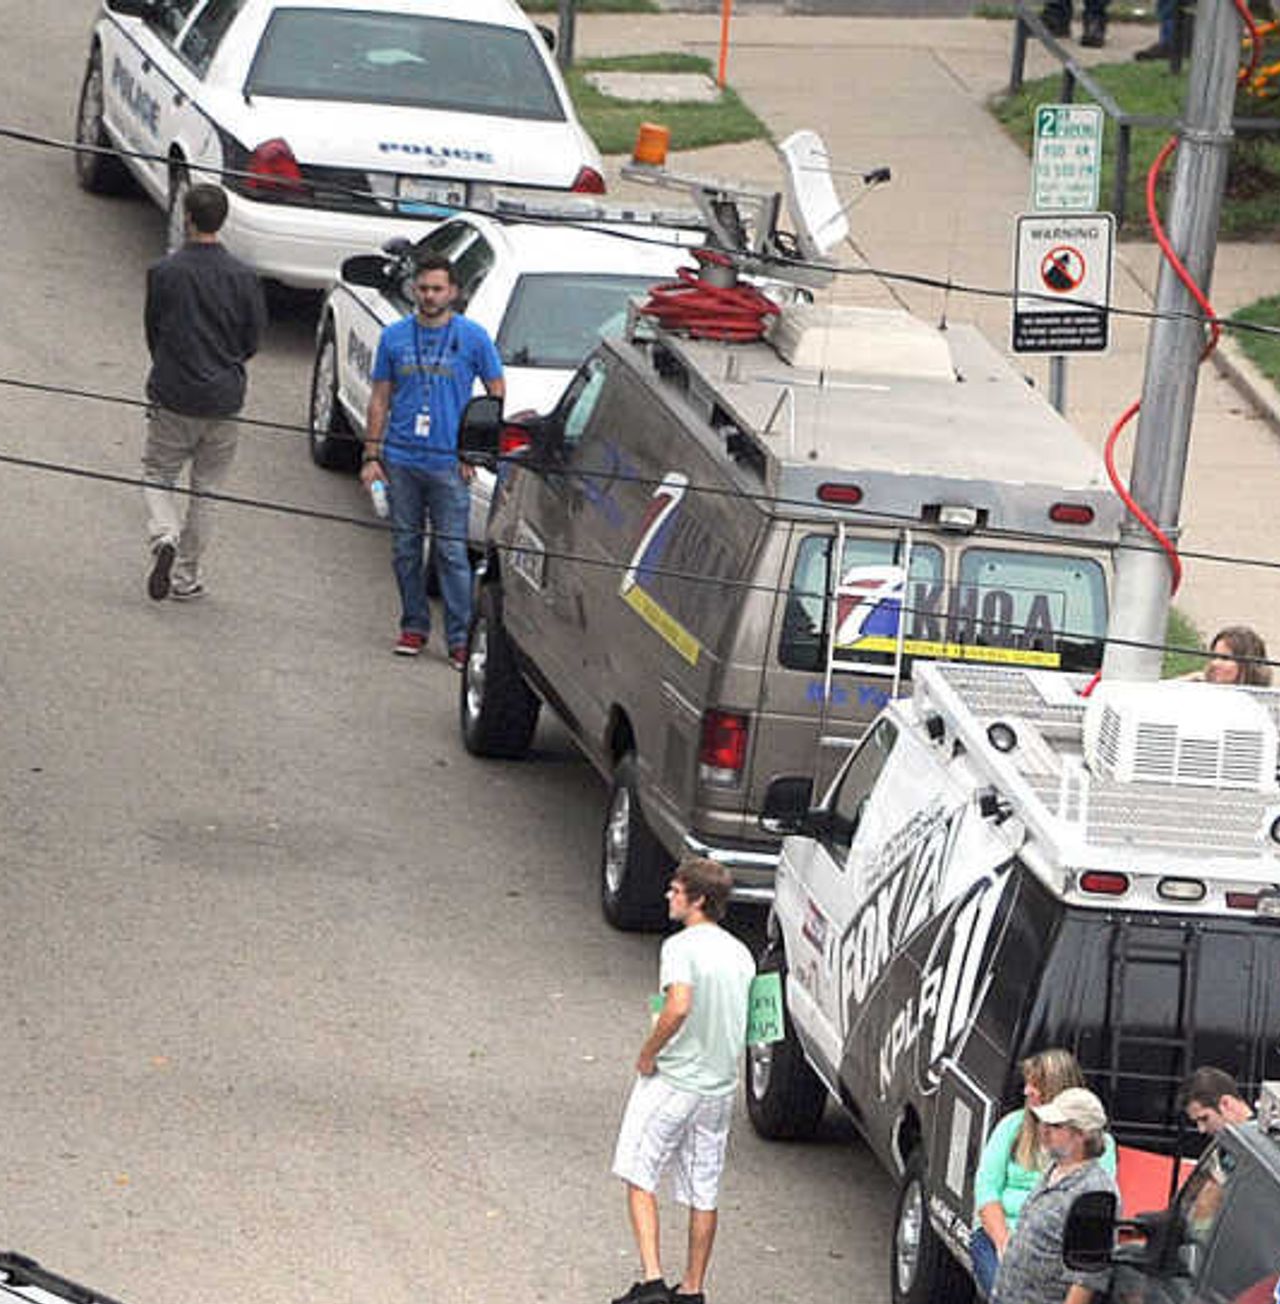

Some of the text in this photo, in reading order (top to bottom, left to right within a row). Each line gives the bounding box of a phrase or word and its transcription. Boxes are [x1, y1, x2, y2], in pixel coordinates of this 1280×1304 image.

[378, 142, 494, 164] POLICE
[1041, 110, 1056, 137] 2
[1031, 227, 1099, 240] WARNING
[622, 472, 689, 597] 7
[836, 565, 905, 646] 7
[841, 862, 912, 1038] FOX
[879, 964, 945, 1102] KPLR
[931, 865, 1014, 1064] 11
